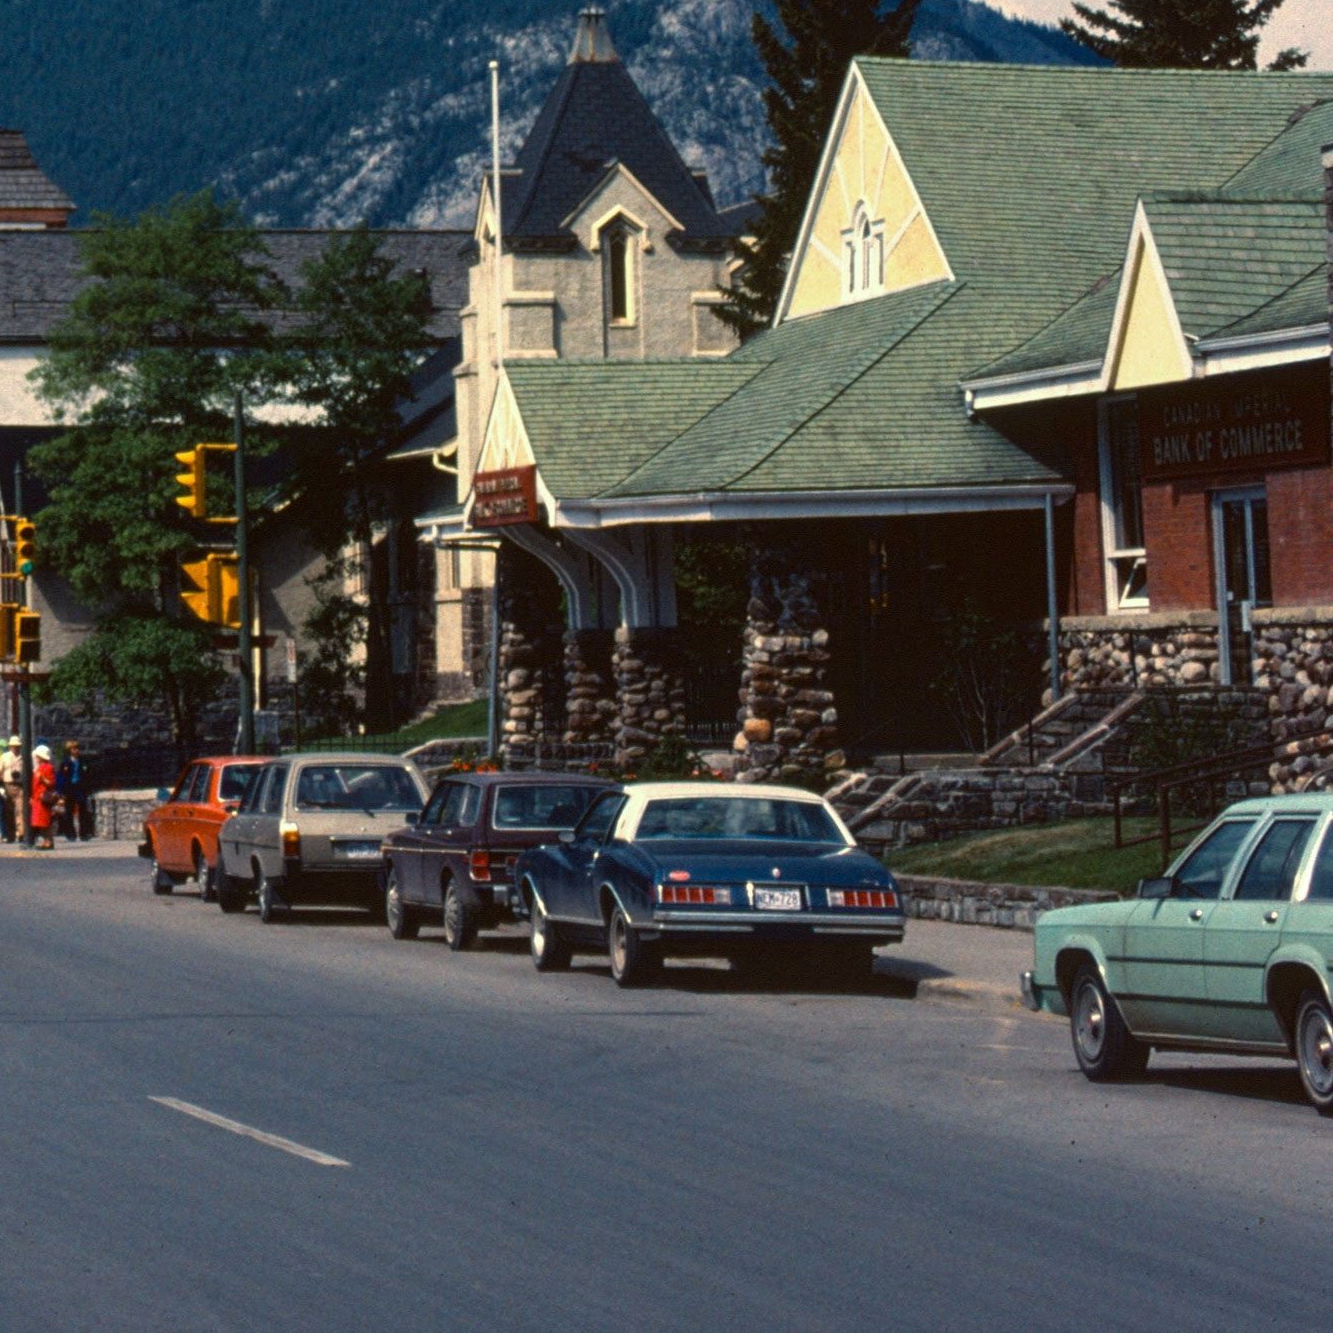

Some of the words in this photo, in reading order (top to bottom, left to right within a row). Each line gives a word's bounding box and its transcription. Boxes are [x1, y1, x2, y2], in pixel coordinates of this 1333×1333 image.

[1153, 434, 1192, 465] BANK
[1197, 430, 1214, 462] OF
[1219, 418, 1304, 460] COMMERCE
